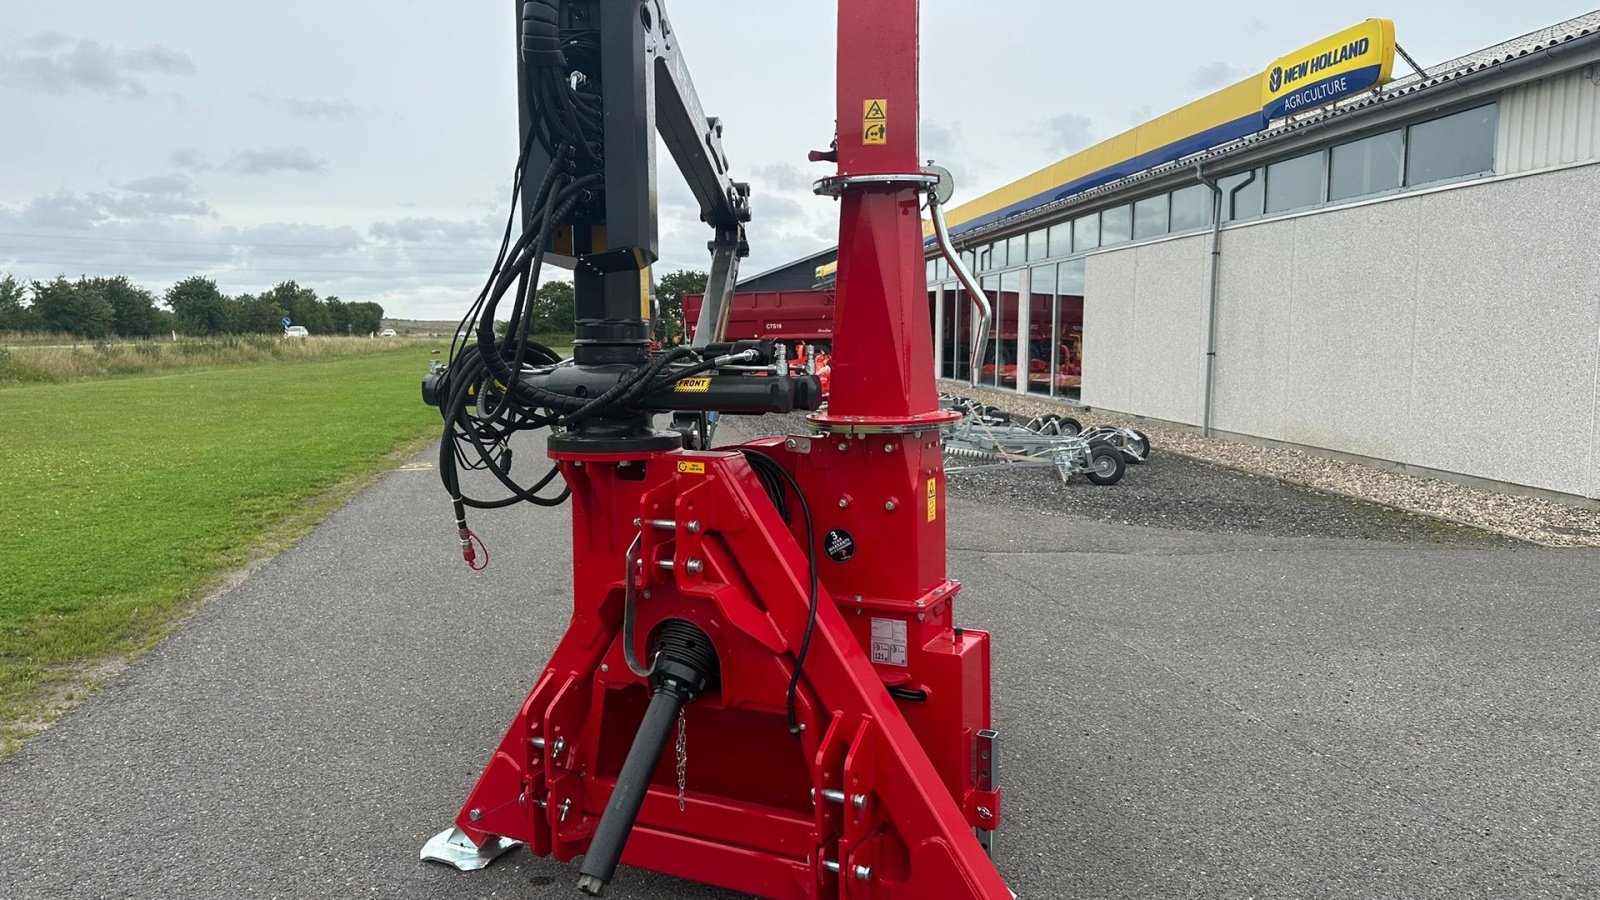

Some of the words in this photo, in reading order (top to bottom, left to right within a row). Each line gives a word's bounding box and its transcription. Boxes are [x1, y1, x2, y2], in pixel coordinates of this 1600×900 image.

[1283, 60, 1310, 85] NEW
[1309, 37, 1369, 74] HOLLAND
[1284, 77, 1348, 111] AGRICULTURE
[830, 530, 838, 541] 3
